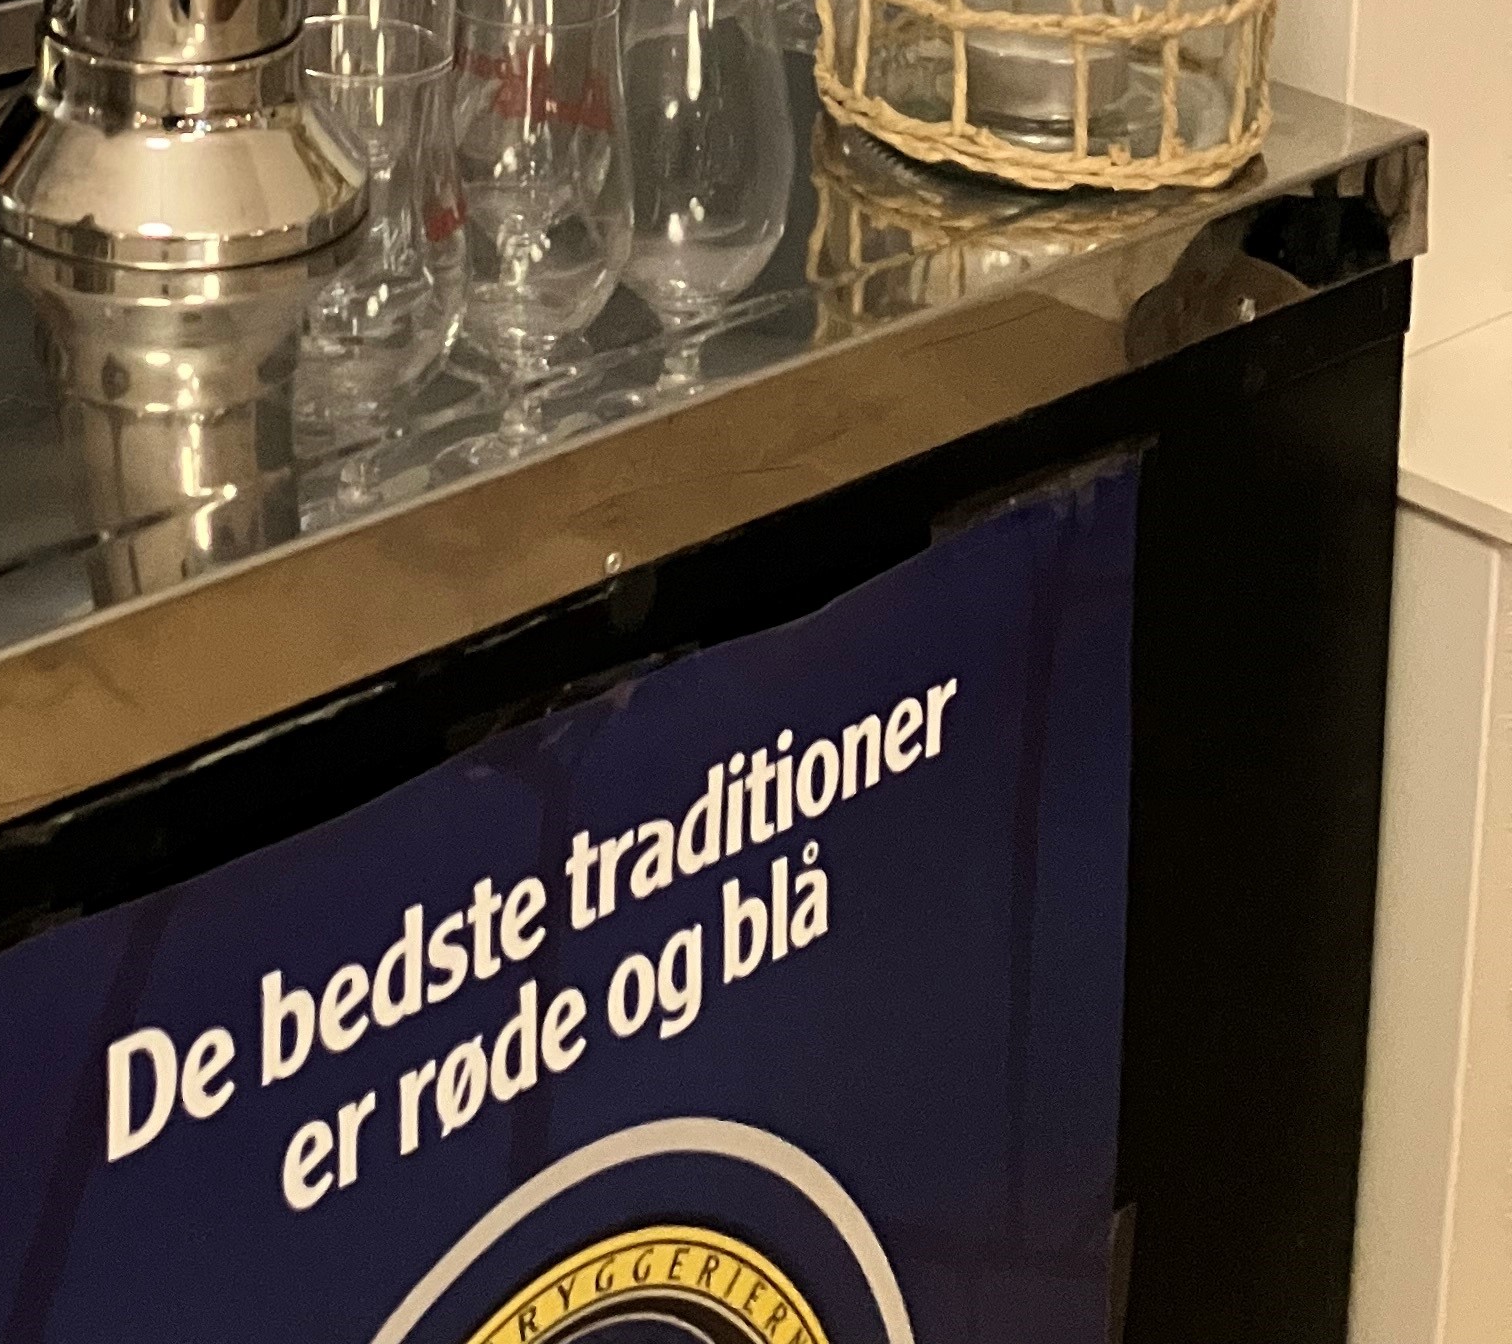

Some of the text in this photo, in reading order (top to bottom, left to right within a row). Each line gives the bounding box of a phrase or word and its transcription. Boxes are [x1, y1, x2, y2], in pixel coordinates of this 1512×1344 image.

[105, 676, 959, 1163] De bedste traditioner
[281, 839, 831, 1213] er røde og blå
